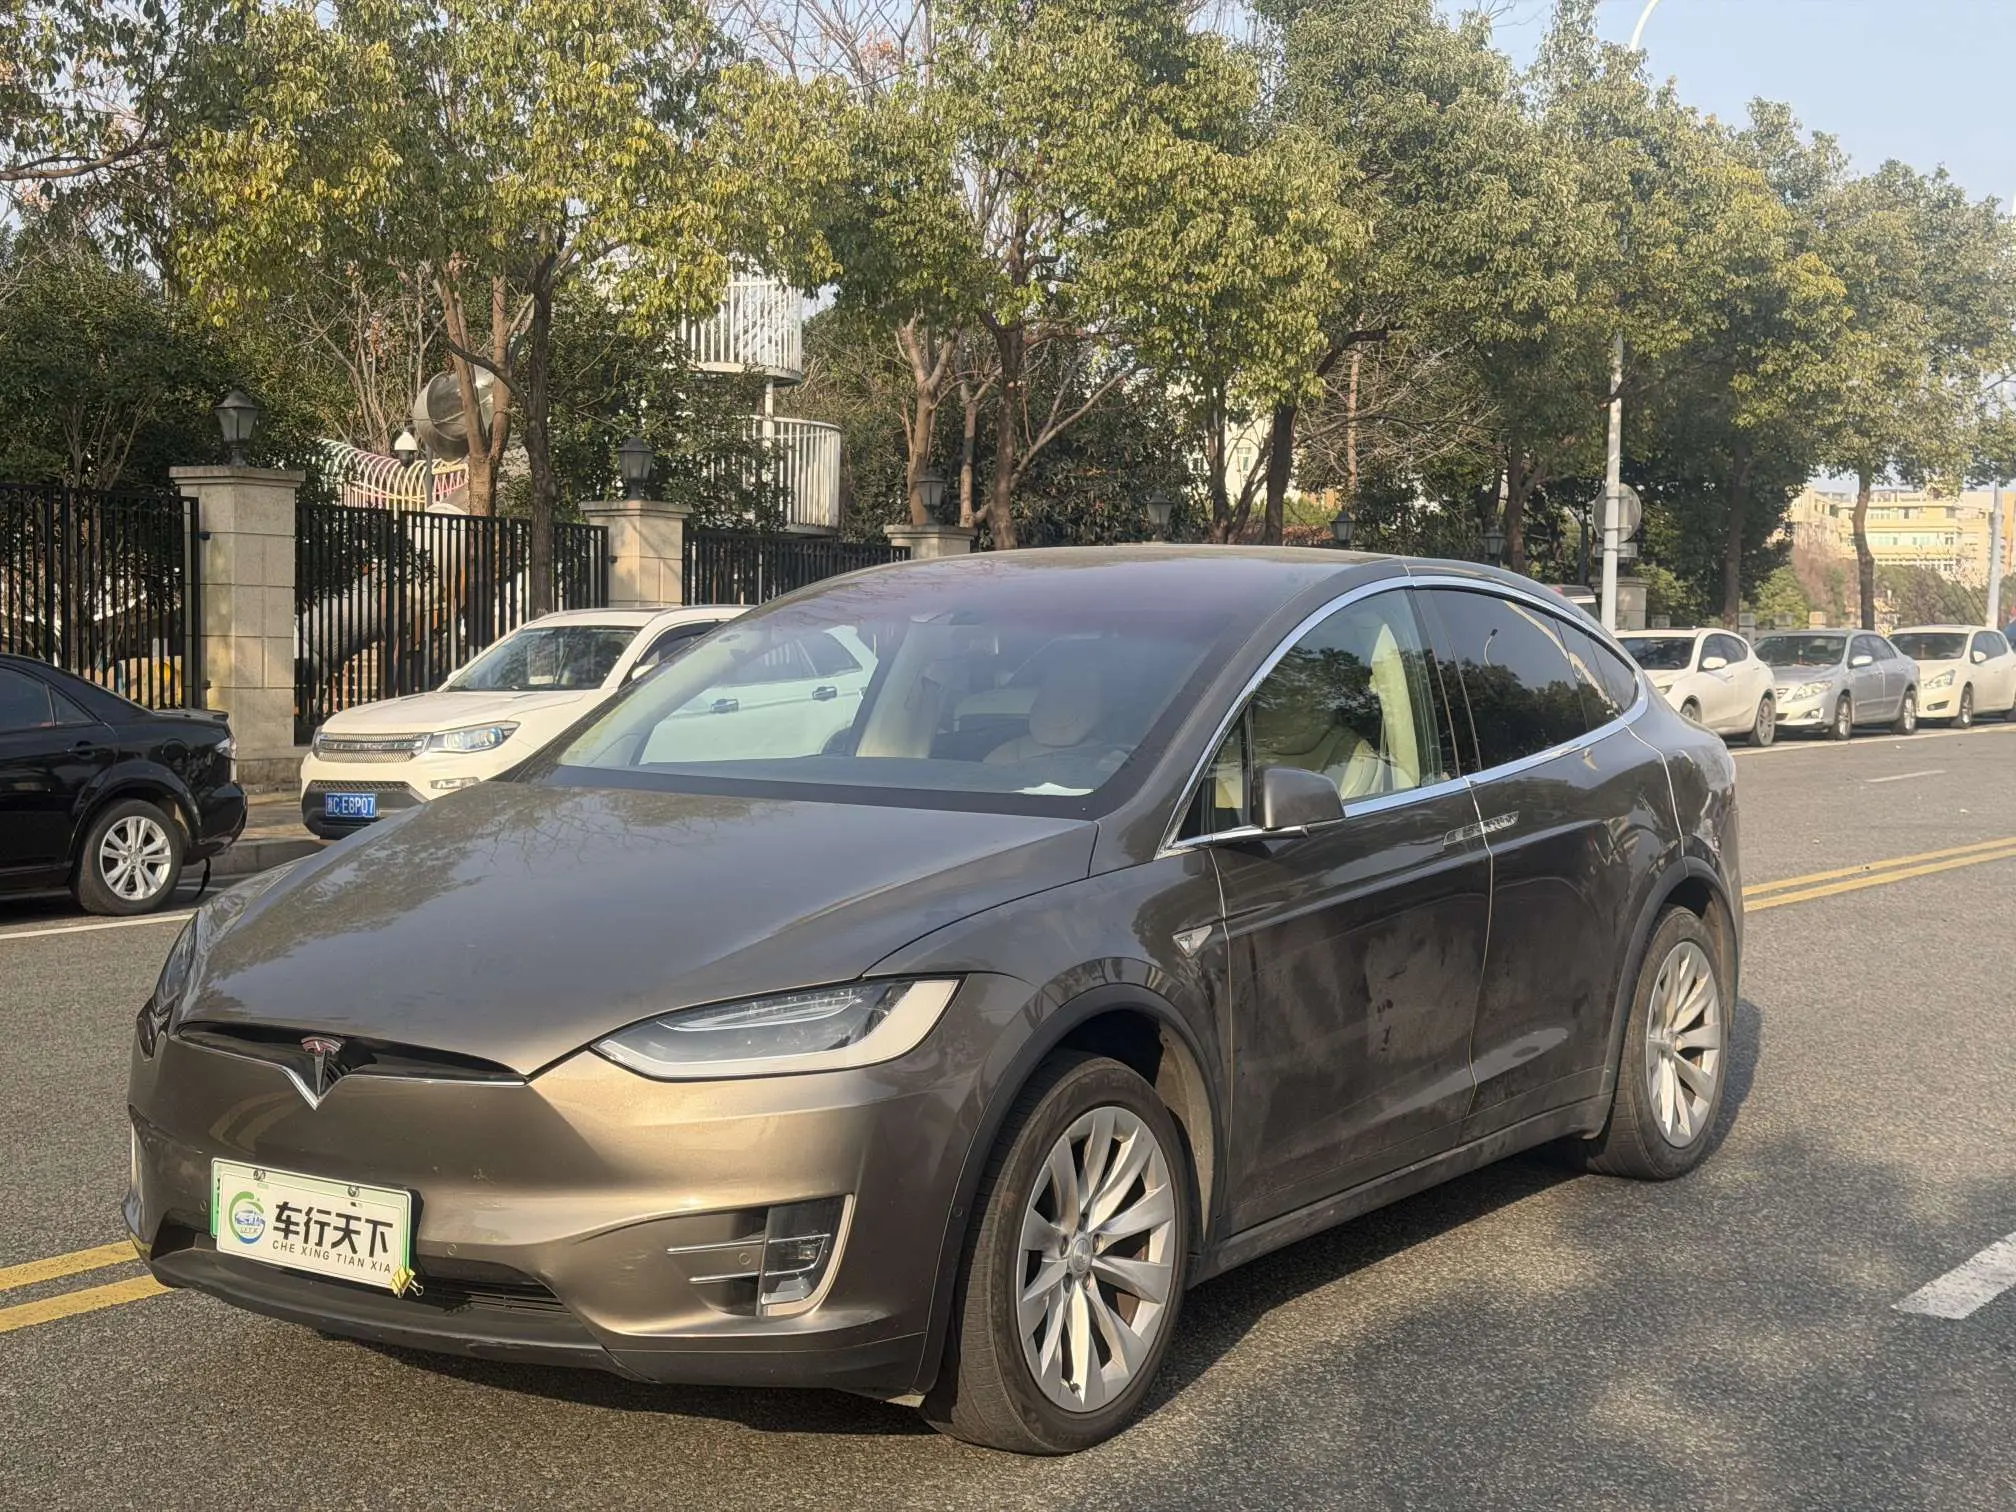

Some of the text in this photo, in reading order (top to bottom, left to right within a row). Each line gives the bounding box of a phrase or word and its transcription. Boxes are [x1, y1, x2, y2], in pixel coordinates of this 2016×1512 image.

[273, 1201, 394, 1258] 车行天下
[272, 1240, 391, 1273] CHE XING TIAN XIA
